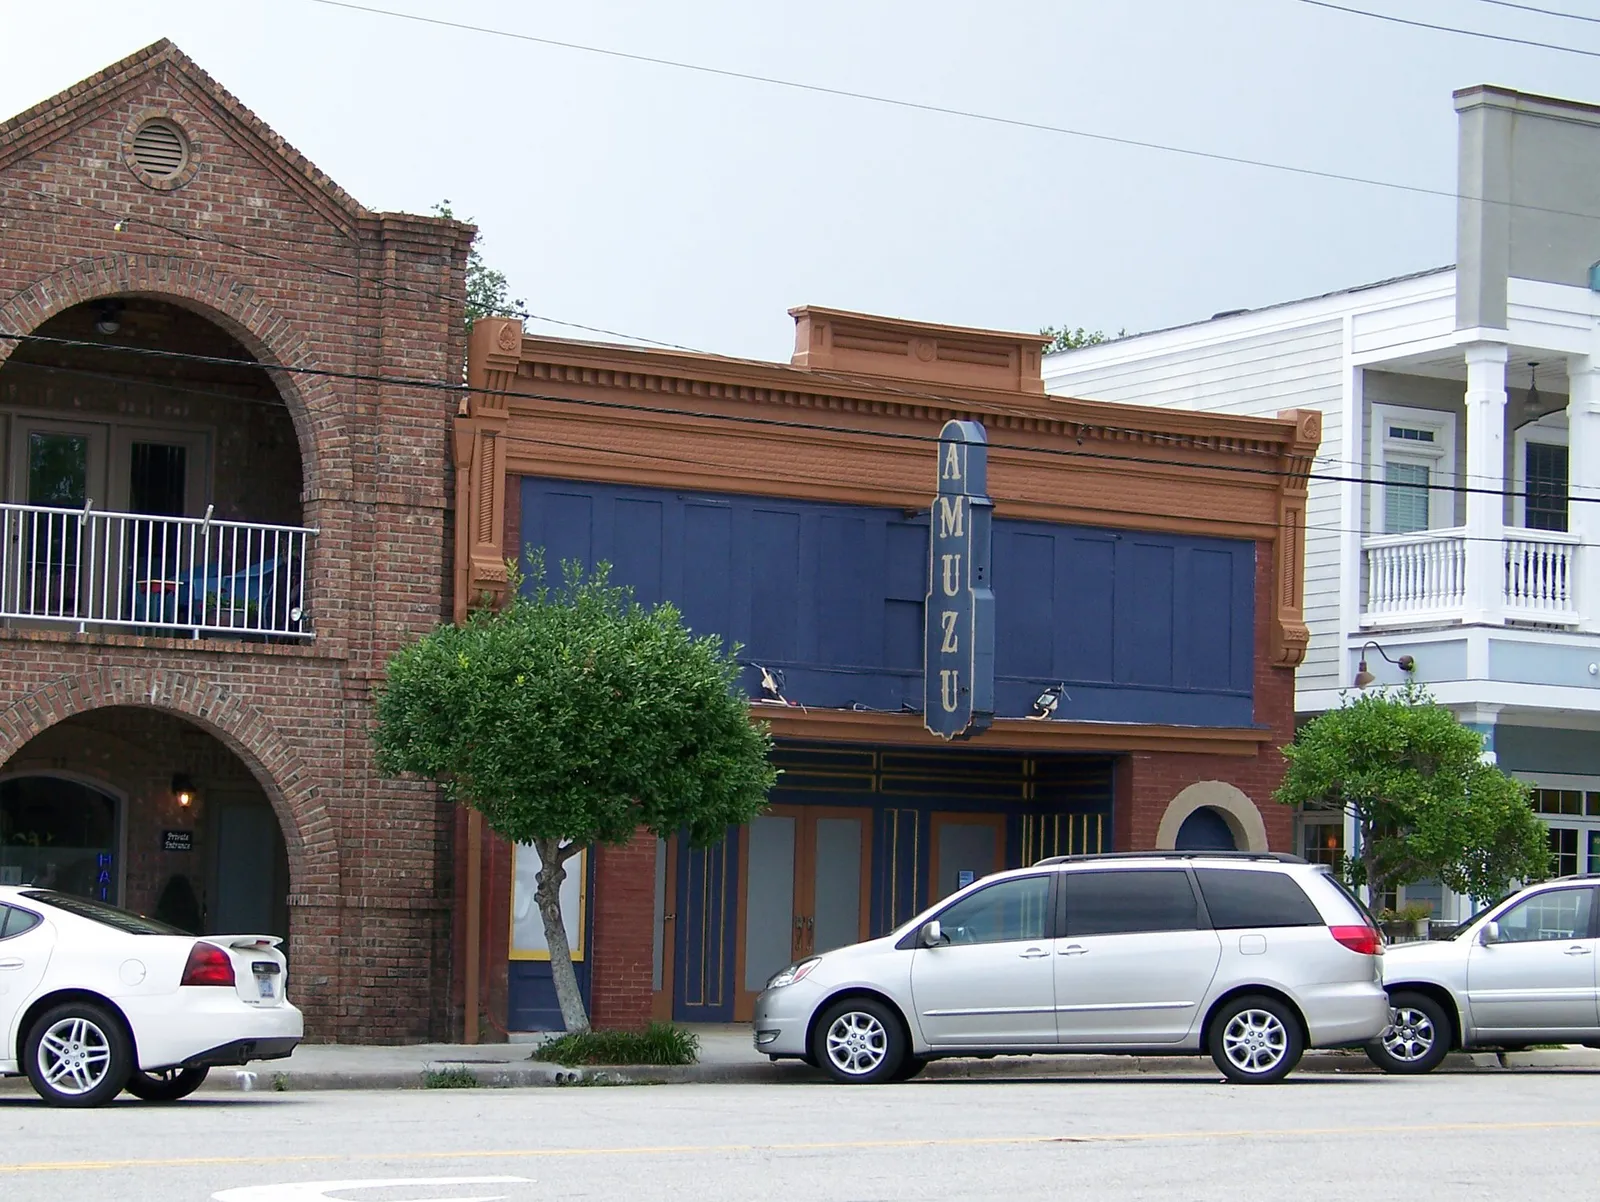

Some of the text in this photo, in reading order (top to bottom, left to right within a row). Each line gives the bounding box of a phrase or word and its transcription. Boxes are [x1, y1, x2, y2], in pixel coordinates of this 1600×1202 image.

[939, 440, 964, 712] AMUZU
[167, 832, 189, 841] Private
[165, 841, 191, 850] Entrance
